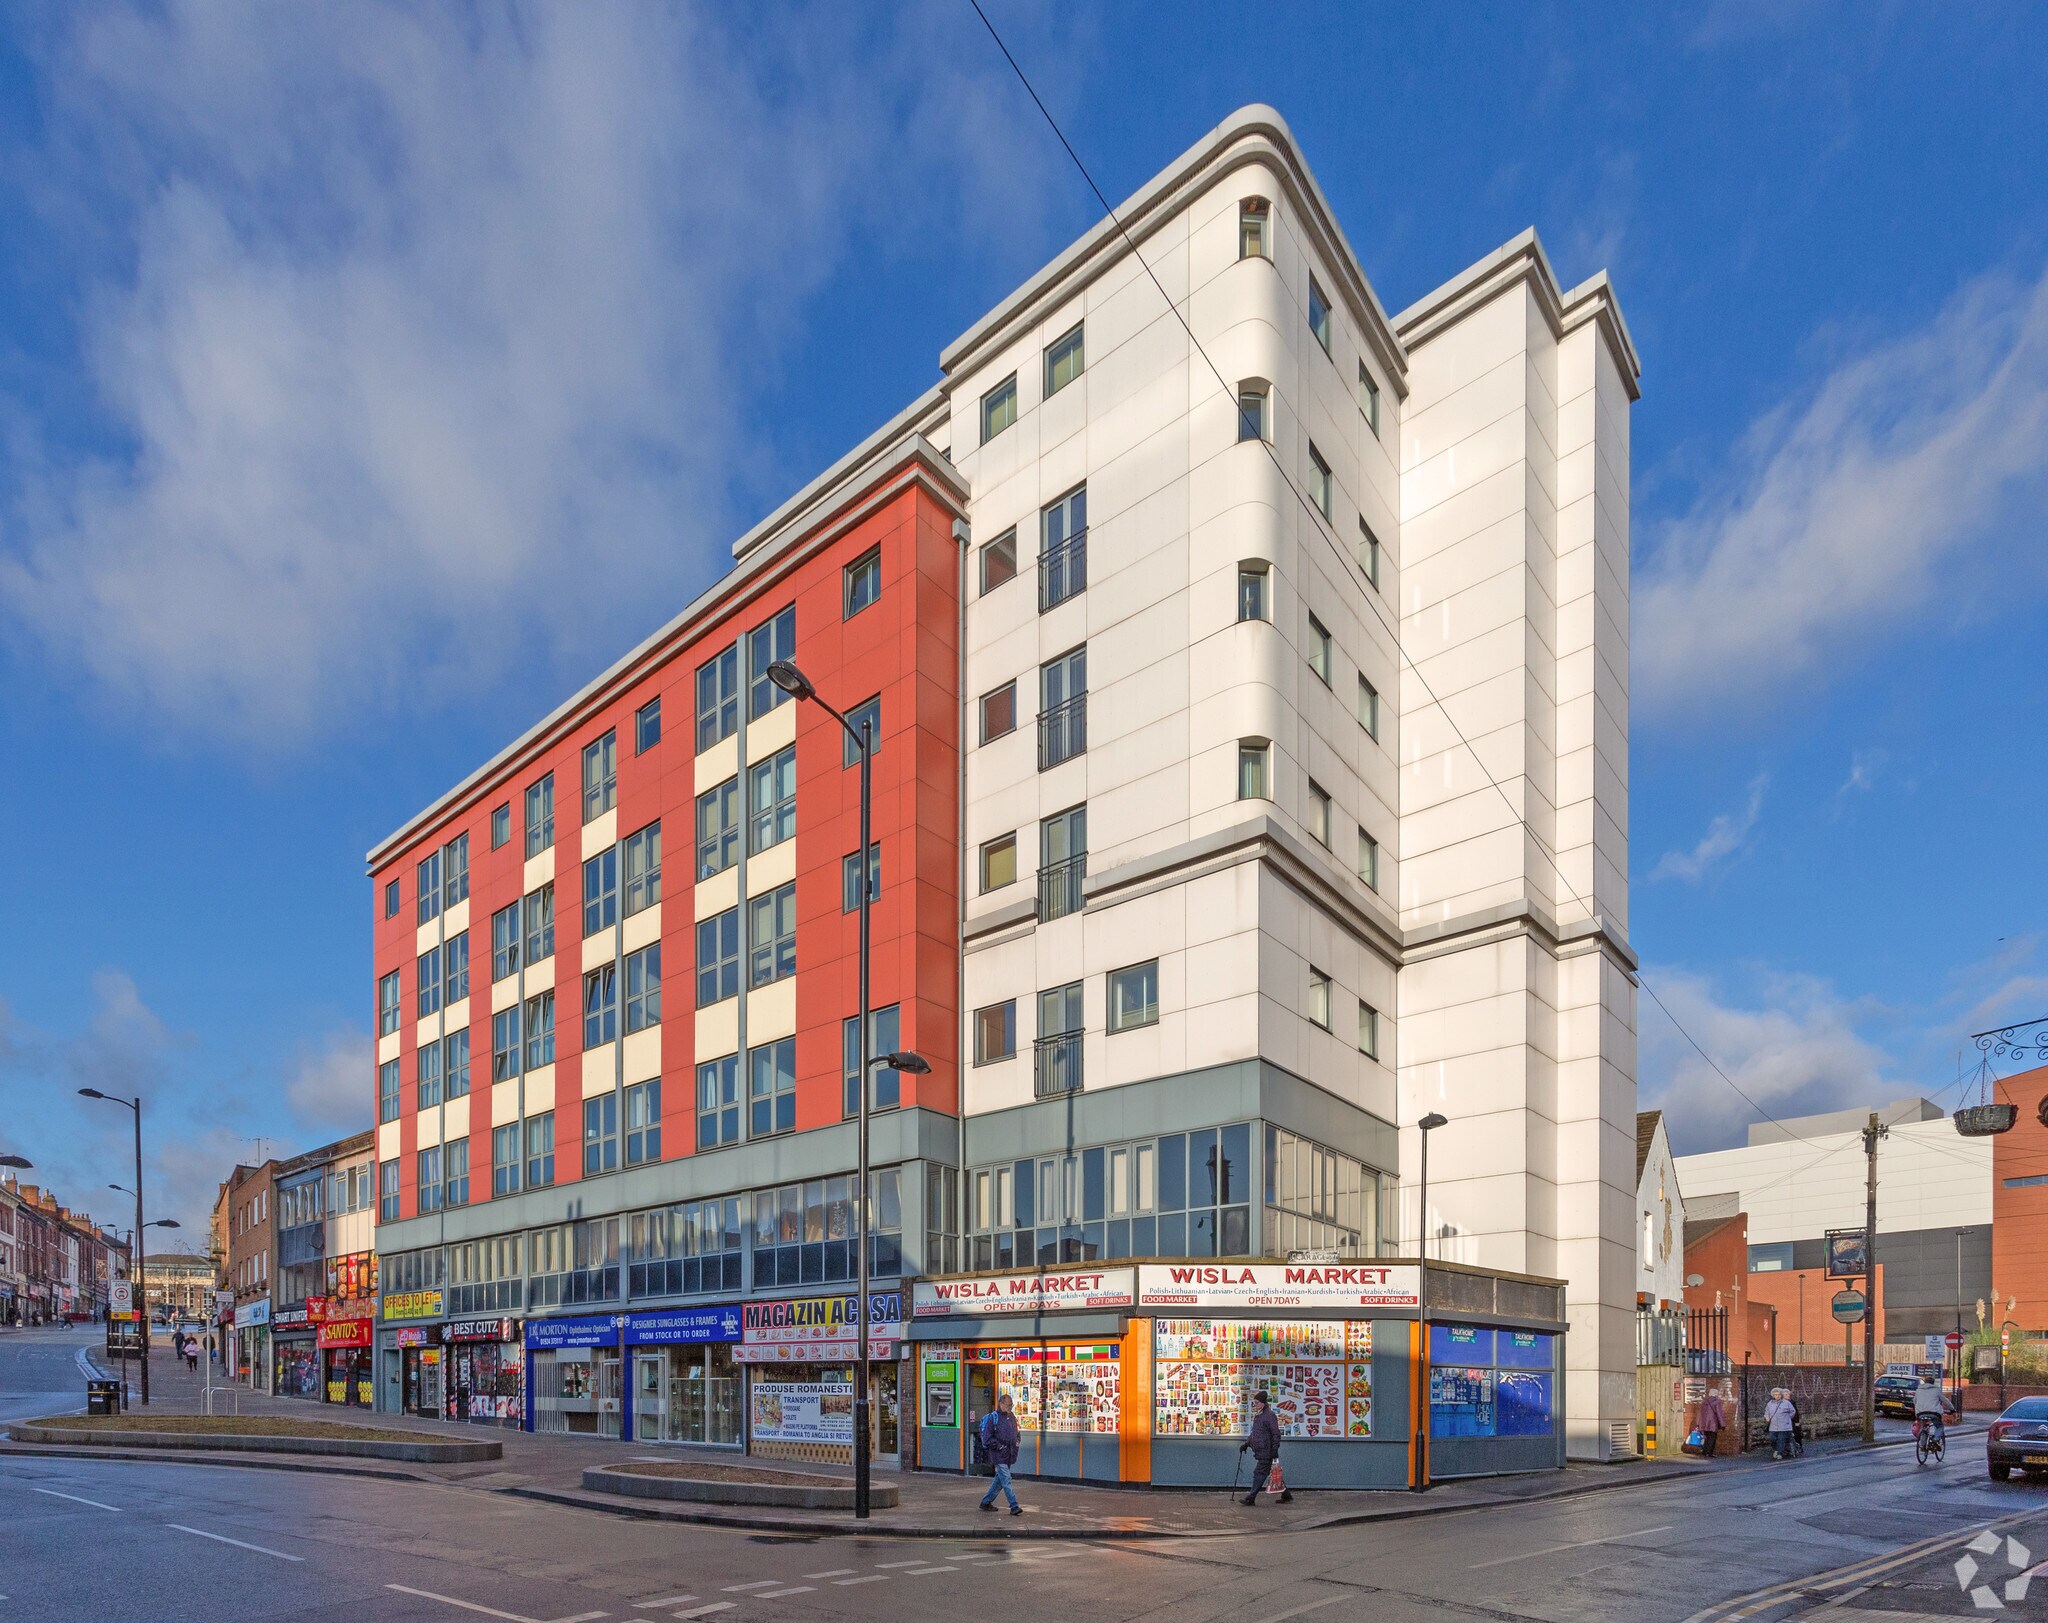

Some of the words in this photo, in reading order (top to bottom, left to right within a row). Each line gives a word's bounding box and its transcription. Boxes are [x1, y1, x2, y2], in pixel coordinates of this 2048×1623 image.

[1169, 1268, 1257, 1284] WISLA
[1285, 1268, 1392, 1285] MARKET
[934, 1281, 1000, 1299] WISLA
[1009, 1274, 1104, 1294] MARKET
[1255, 1287, 1278, 1296] English
[385, 1295, 409, 1308] OFFICES
[411, 1293, 420, 1306] TO
[423, 1292, 432, 1305] LET
[984, 1303, 1015, 1311] OPEN
[1017, 1302, 1025, 1310] 7
[1029, 1300, 1060, 1309] DAYS
[275, 1312, 290, 1323] SMART
[745, 1302, 827, 1329] MAGAZIN
[830, 1296, 900, 1326] ACSA
[632, 1319, 657, 1329] DESIGNER
[657, 1318, 689, 1328] SUNGLASSES
[690, 1317, 695, 1326] &
[695, 1315, 718, 1325] FRAMES
[326, 1322, 358, 1340] SANTO'S
[454, 1322, 474, 1335] BEST
[476, 1321, 498, 1333] CUTZ
[539, 1324, 568, 1336] MORTON
[569, 1326, 592, 1336] Ophthalmic
[592, 1324, 611, 1334] Optician
[655, 1331, 672, 1339] STOCK
[682, 1330, 691, 1338] TO
[691, 1329, 710, 1337] ORDER
[932, 1369, 948, 1377] cash
[754, 1385, 795, 1393] PRODUSE
[797, 1385, 852, 1393] ROMANESTI
[783, 1396, 819, 1404] TRANSPORT
[782, 1430, 804, 1438] ROMANIA
[811, 1431, 828, 1439] ANGLIA
